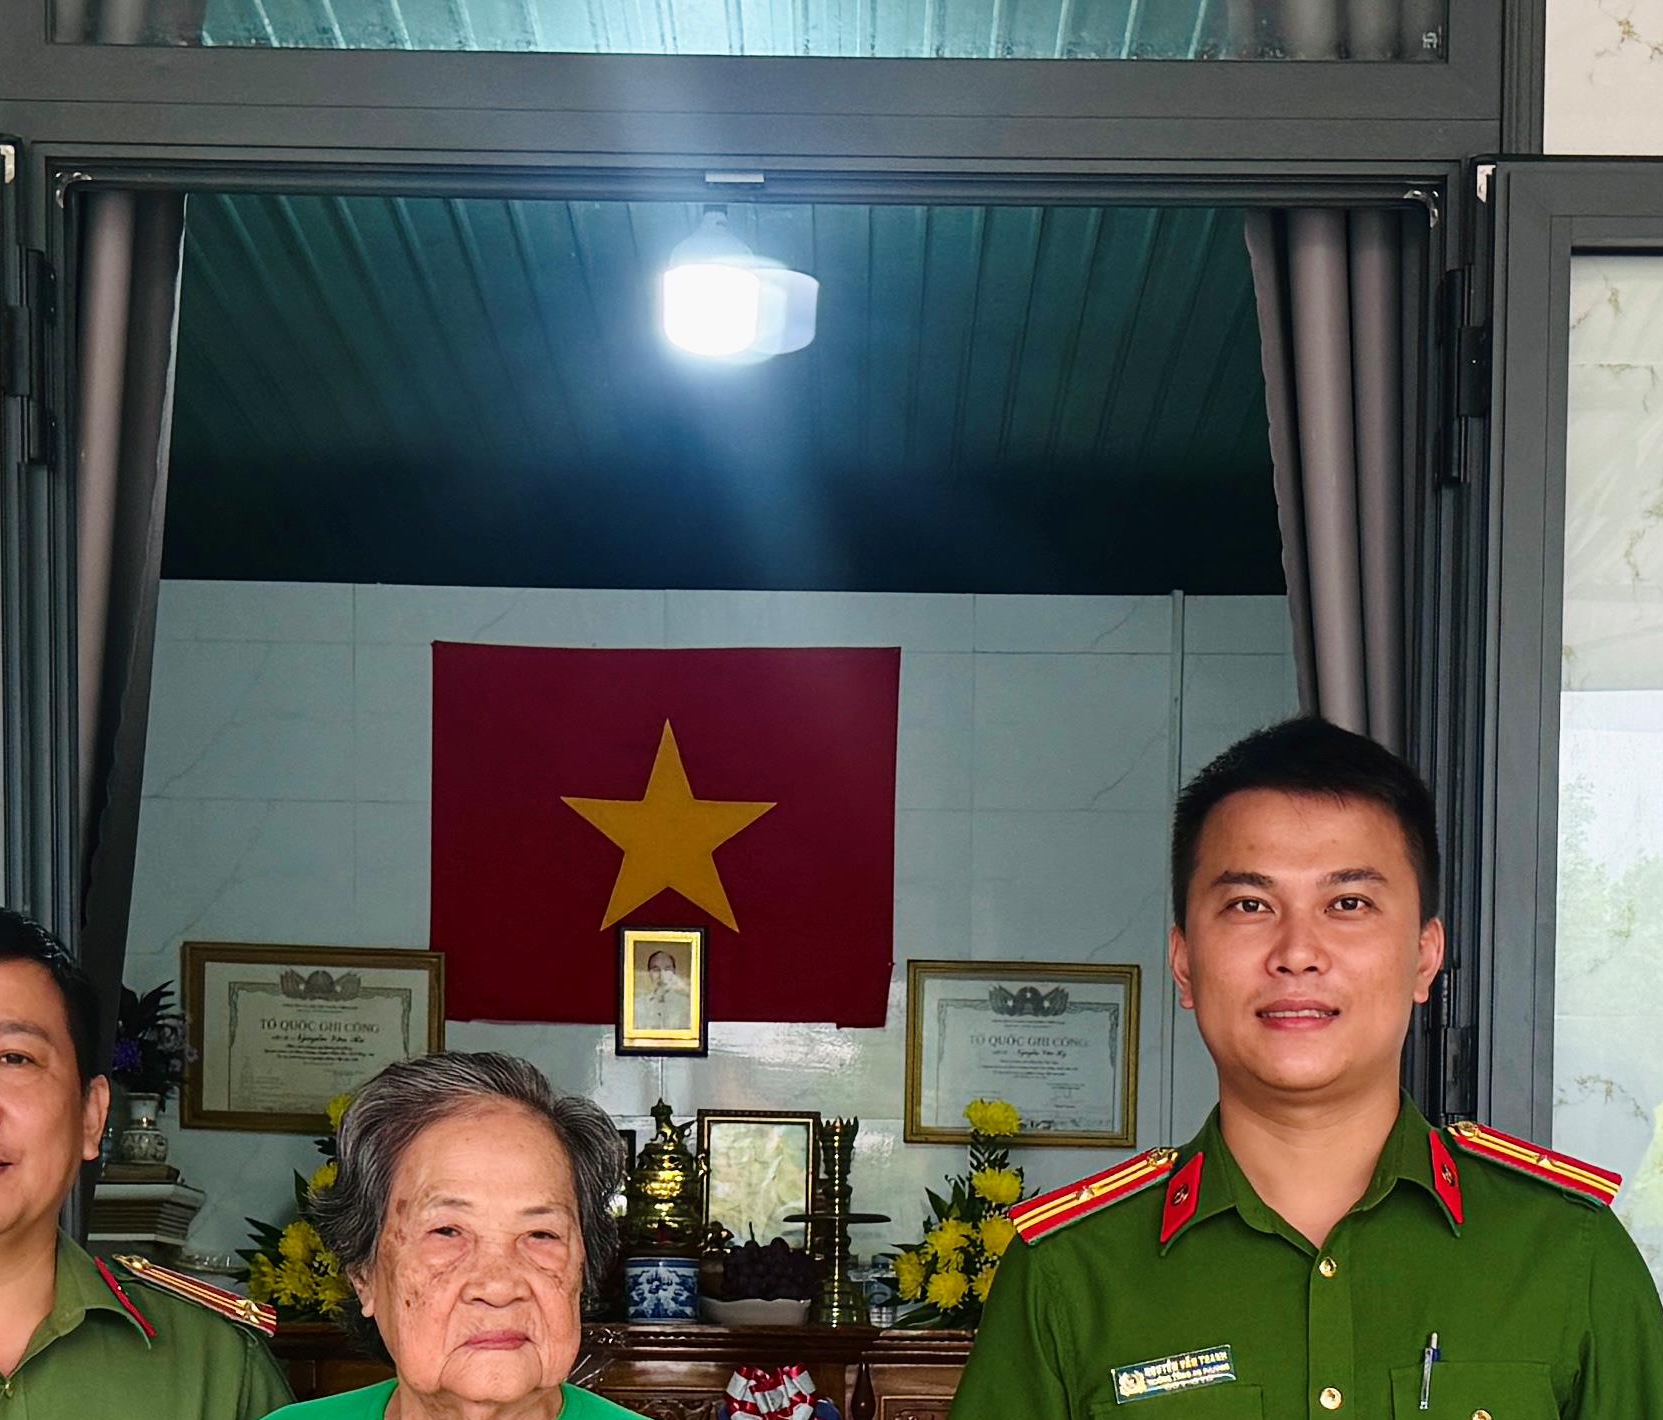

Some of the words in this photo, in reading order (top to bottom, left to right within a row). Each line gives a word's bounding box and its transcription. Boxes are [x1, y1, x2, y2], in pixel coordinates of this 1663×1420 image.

[280, 1019, 316, 1032] QUỐC
[319, 1021, 342, 1032] GHI
[344, 1021, 379, 1033] CÔNG
[988, 1034, 1023, 1048] QUỐC
[1027, 1036, 1050, 1047] GHI
